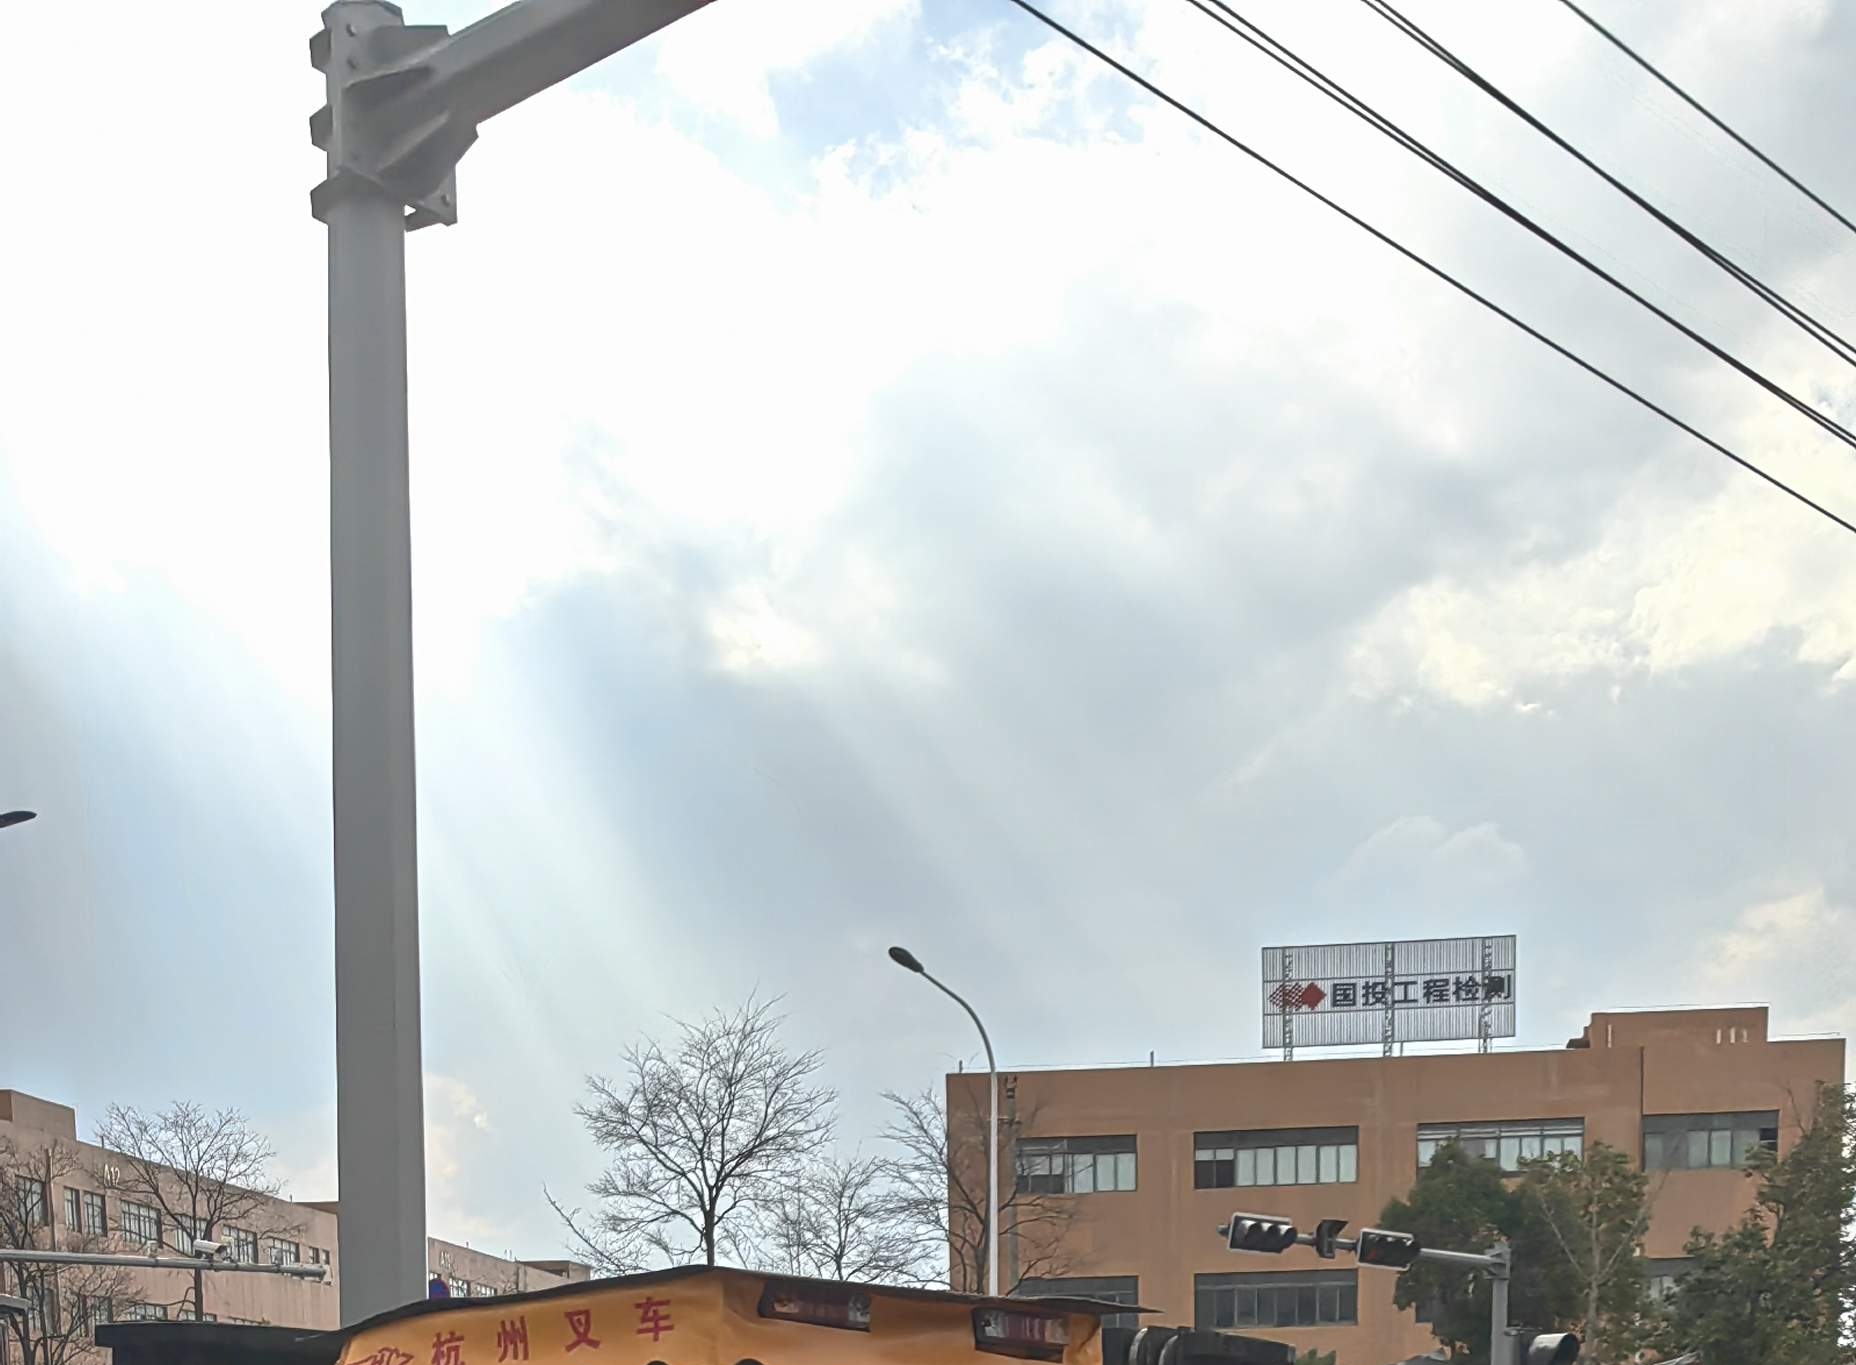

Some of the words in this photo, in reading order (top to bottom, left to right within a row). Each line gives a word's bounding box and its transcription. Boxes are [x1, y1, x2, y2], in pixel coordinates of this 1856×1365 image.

[1332, 975, 1511, 1008] 国投工程检测
